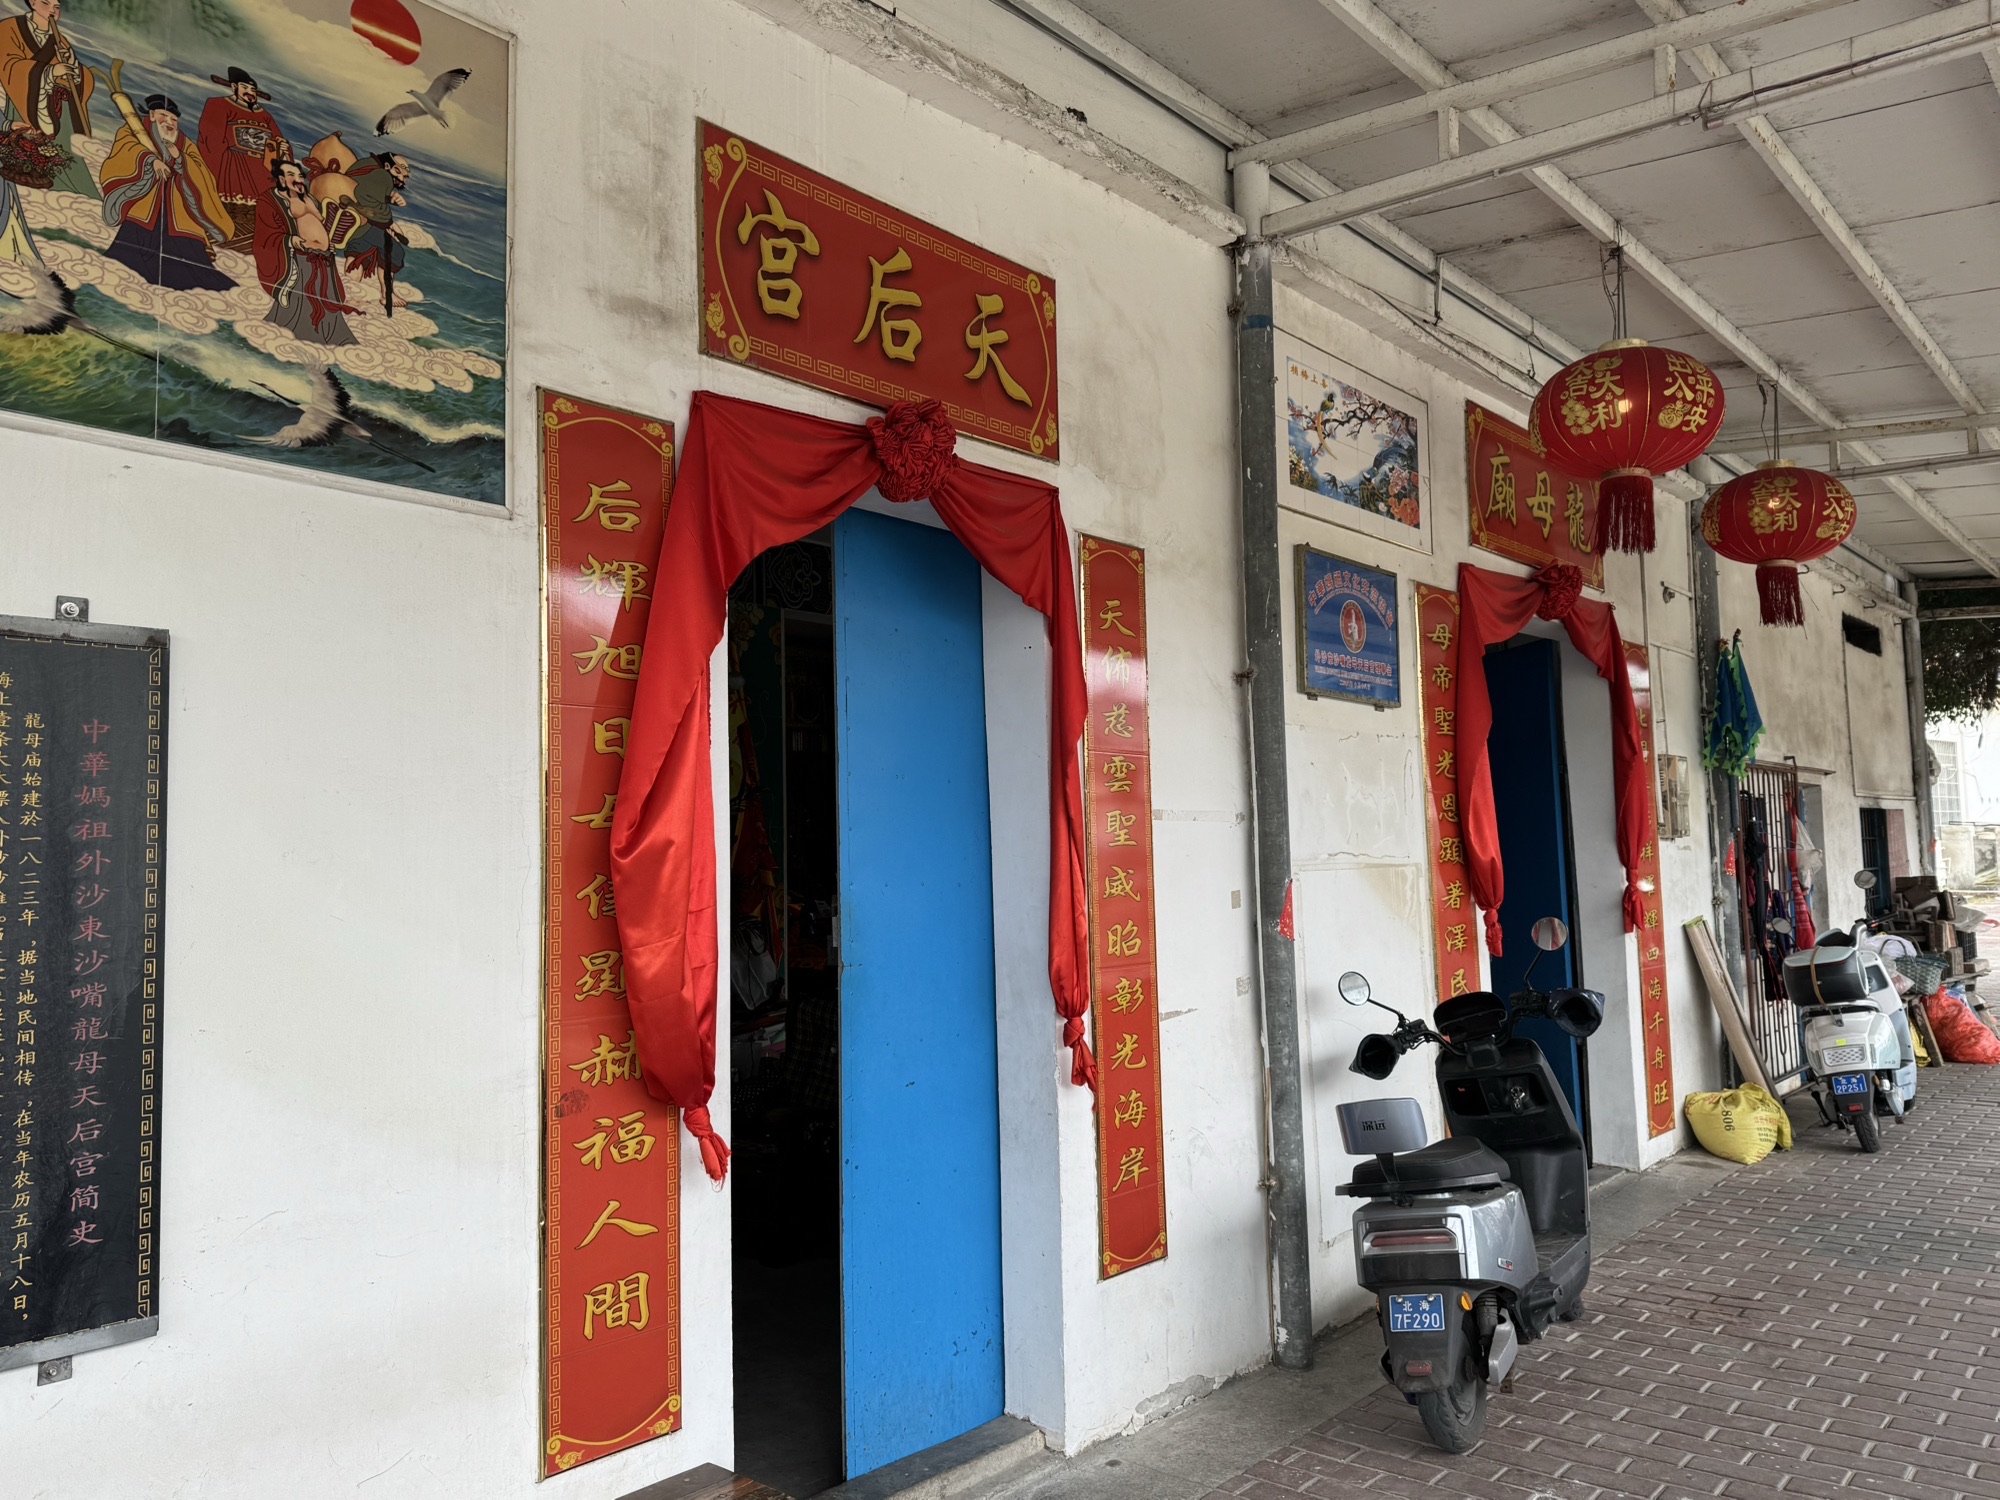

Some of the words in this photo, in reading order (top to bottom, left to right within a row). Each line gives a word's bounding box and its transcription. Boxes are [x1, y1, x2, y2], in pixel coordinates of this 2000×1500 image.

[1836, 1083, 1864, 1094] 2P251
[1403, 1300, 1430, 1311] 北海
[1394, 1313, 1440, 1329] 7F290
